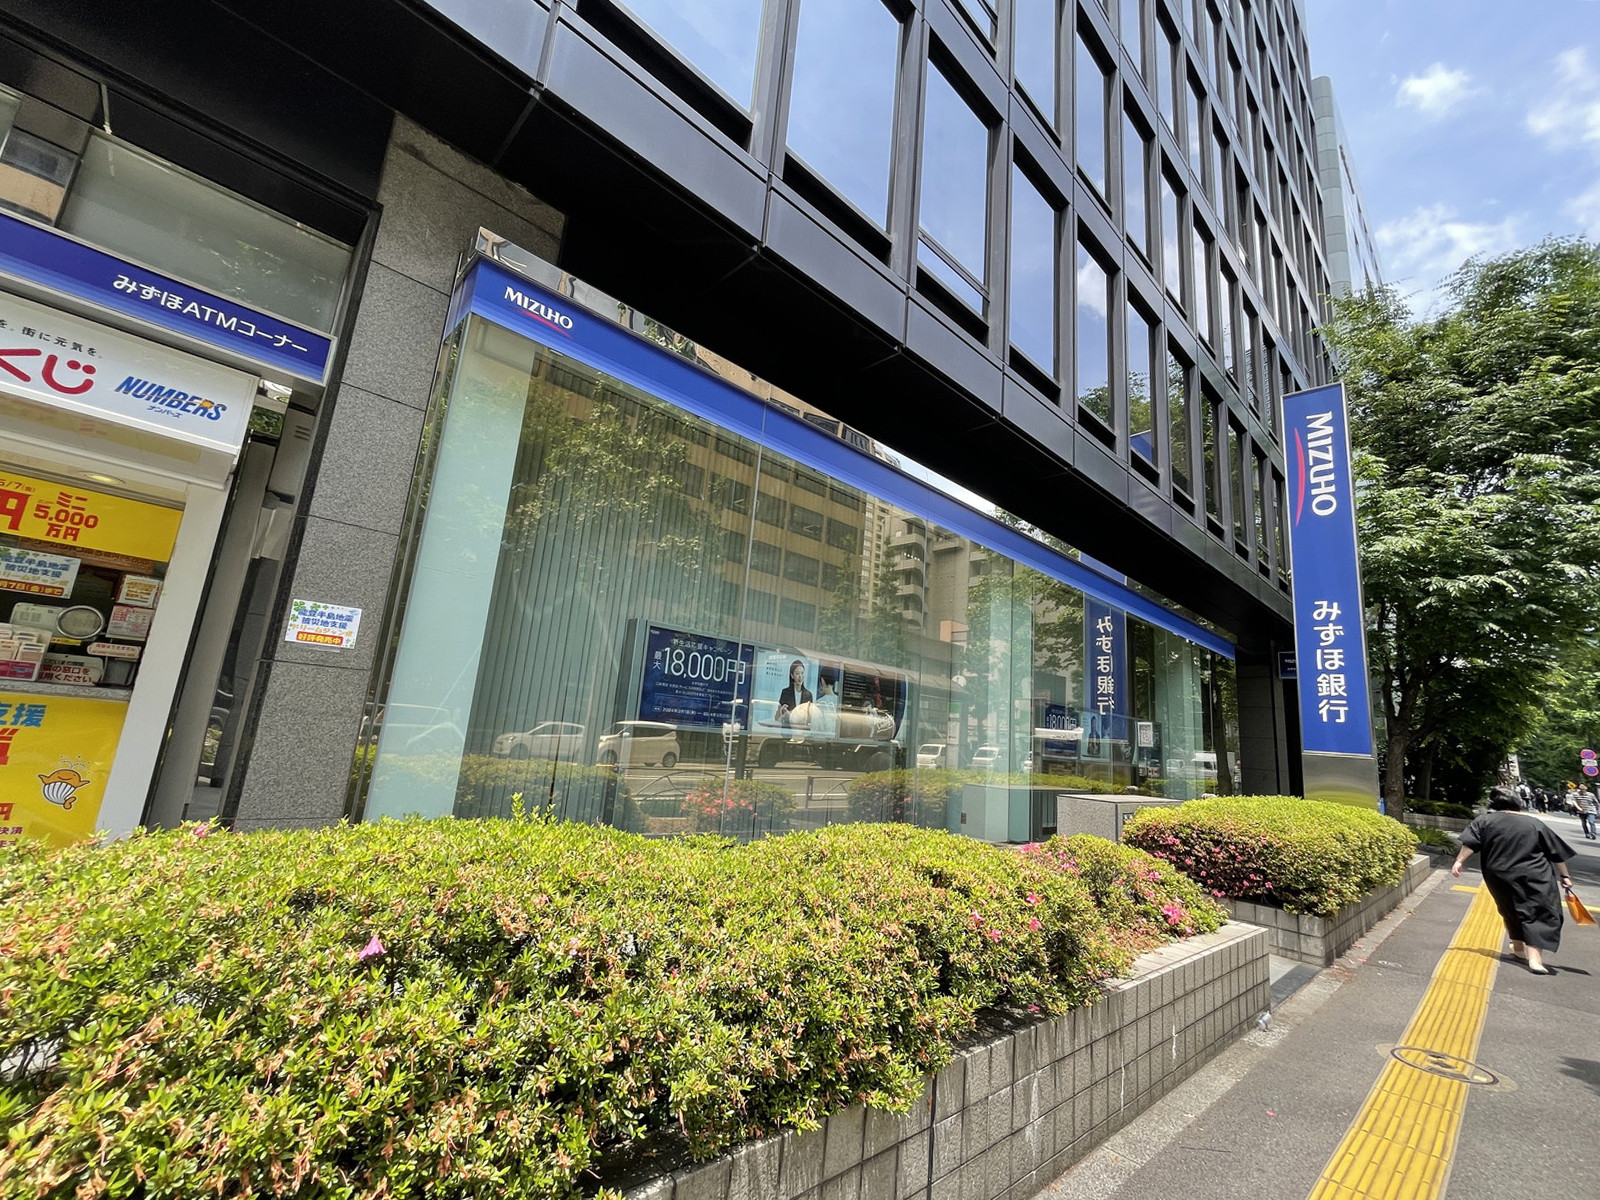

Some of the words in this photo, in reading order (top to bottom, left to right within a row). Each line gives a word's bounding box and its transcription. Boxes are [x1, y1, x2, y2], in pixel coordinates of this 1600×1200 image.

[113, 274, 308, 352] みずほATMコーナー
[504, 286, 574, 330] MIZUHO
[114, 376, 227, 422] NUMBERS
[147, 405, 183, 419] ナンバーズ
[1306, 411, 1337, 517] MIZUHO
[56, 491, 88, 512] ミニ
[45, 522, 80, 542] 万円
[663, 647, 746, 685] 18,000円
[1312, 600, 1349, 724] みずほ銀行
